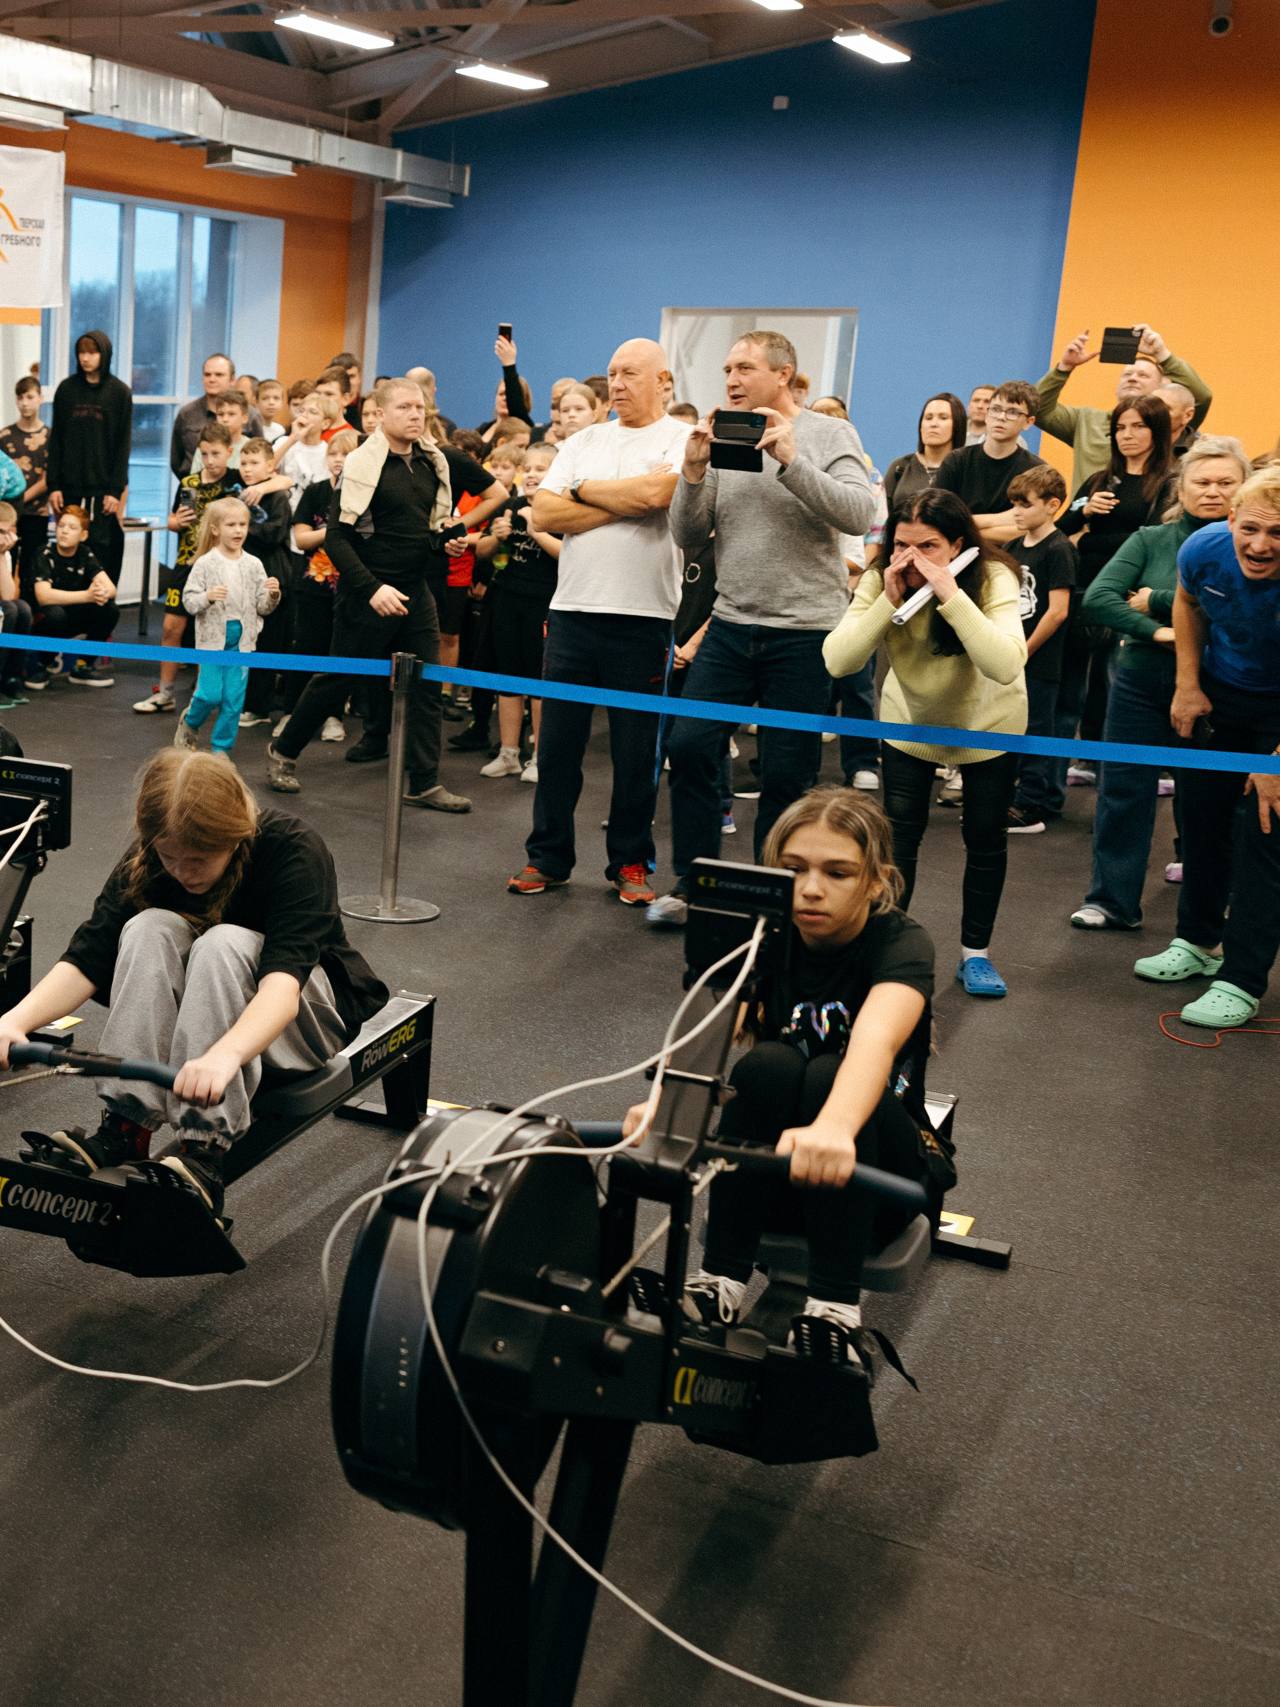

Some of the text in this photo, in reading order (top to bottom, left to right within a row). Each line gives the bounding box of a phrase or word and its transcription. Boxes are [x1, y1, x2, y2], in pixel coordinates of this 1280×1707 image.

[0, 233, 41, 247] ГРЕБНОГО
[7, 1184, 113, 1226] concept 2
